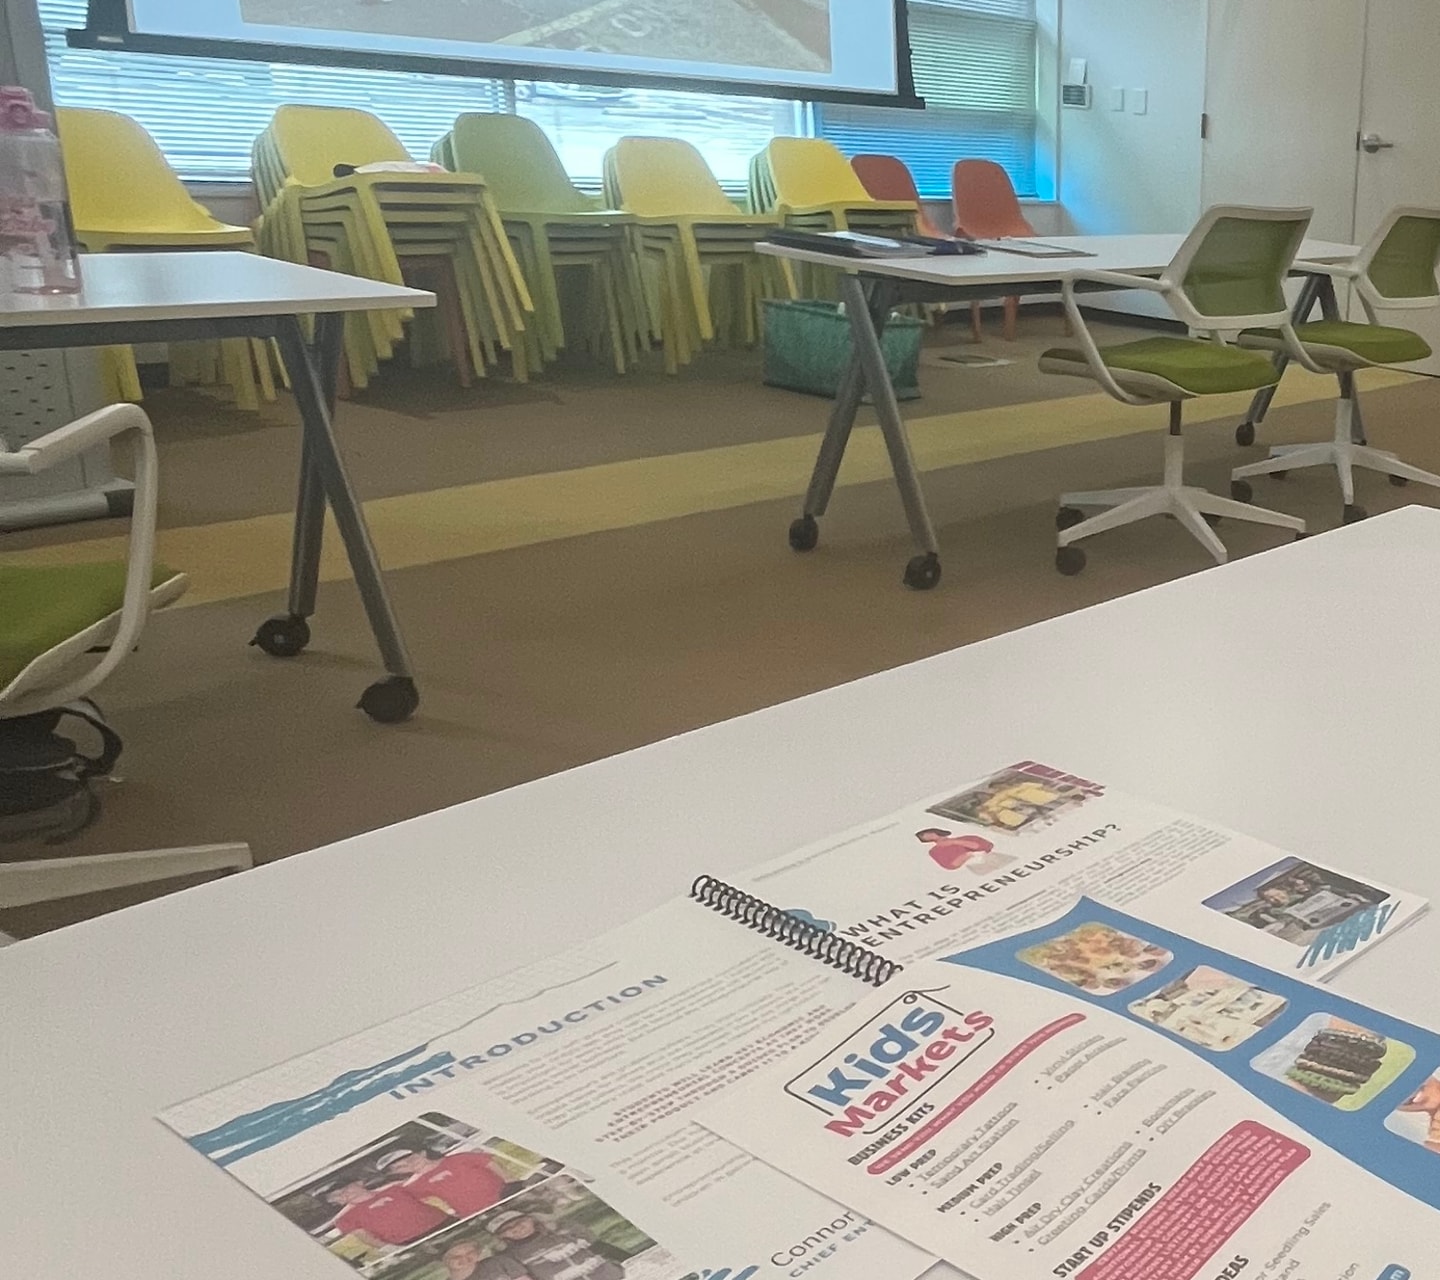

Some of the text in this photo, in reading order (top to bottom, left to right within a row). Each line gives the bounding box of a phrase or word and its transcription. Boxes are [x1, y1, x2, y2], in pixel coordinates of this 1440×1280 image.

[840, 884, 960, 938] WHAT IS
[861, 823, 1121, 947] ENTREPRENEURSHIP?
[389, 974, 668, 1100] INTRODUCTION
[808, 1007, 945, 1107] Kids
[824, 1011, 994, 1137] Markets
[846, 1101, 936, 1165] BUSINESS KITS
[884, 1148, 940, 1186] LOW PREP
[916, 1100, 1019, 1181] Temporary Tattoos
[929, 1117, 1020, 1188] Sand Art Station
[967, 1118, 1078, 1209] Card Trading/Selling
[936, 1161, 1005, 1213] MEDIUM PREP
[981, 1168, 1042, 1216] Hair Tinsel
[989, 1201, 1044, 1242] HIGH PREP
[1021, 1140, 1133, 1238] Air Dry Clay Creations
[1036, 1147, 1148, 1246] Greeting Cards/Prints
[771, 1211, 855, 1266] Connor
[789, 1243, 837, 1278] CHIEF
[1051, 1181, 1163, 1279] START UP STIPENDS
[1263, 1225, 1312, 1271] Seedling
[1302, 1200, 1332, 1227] Sales
